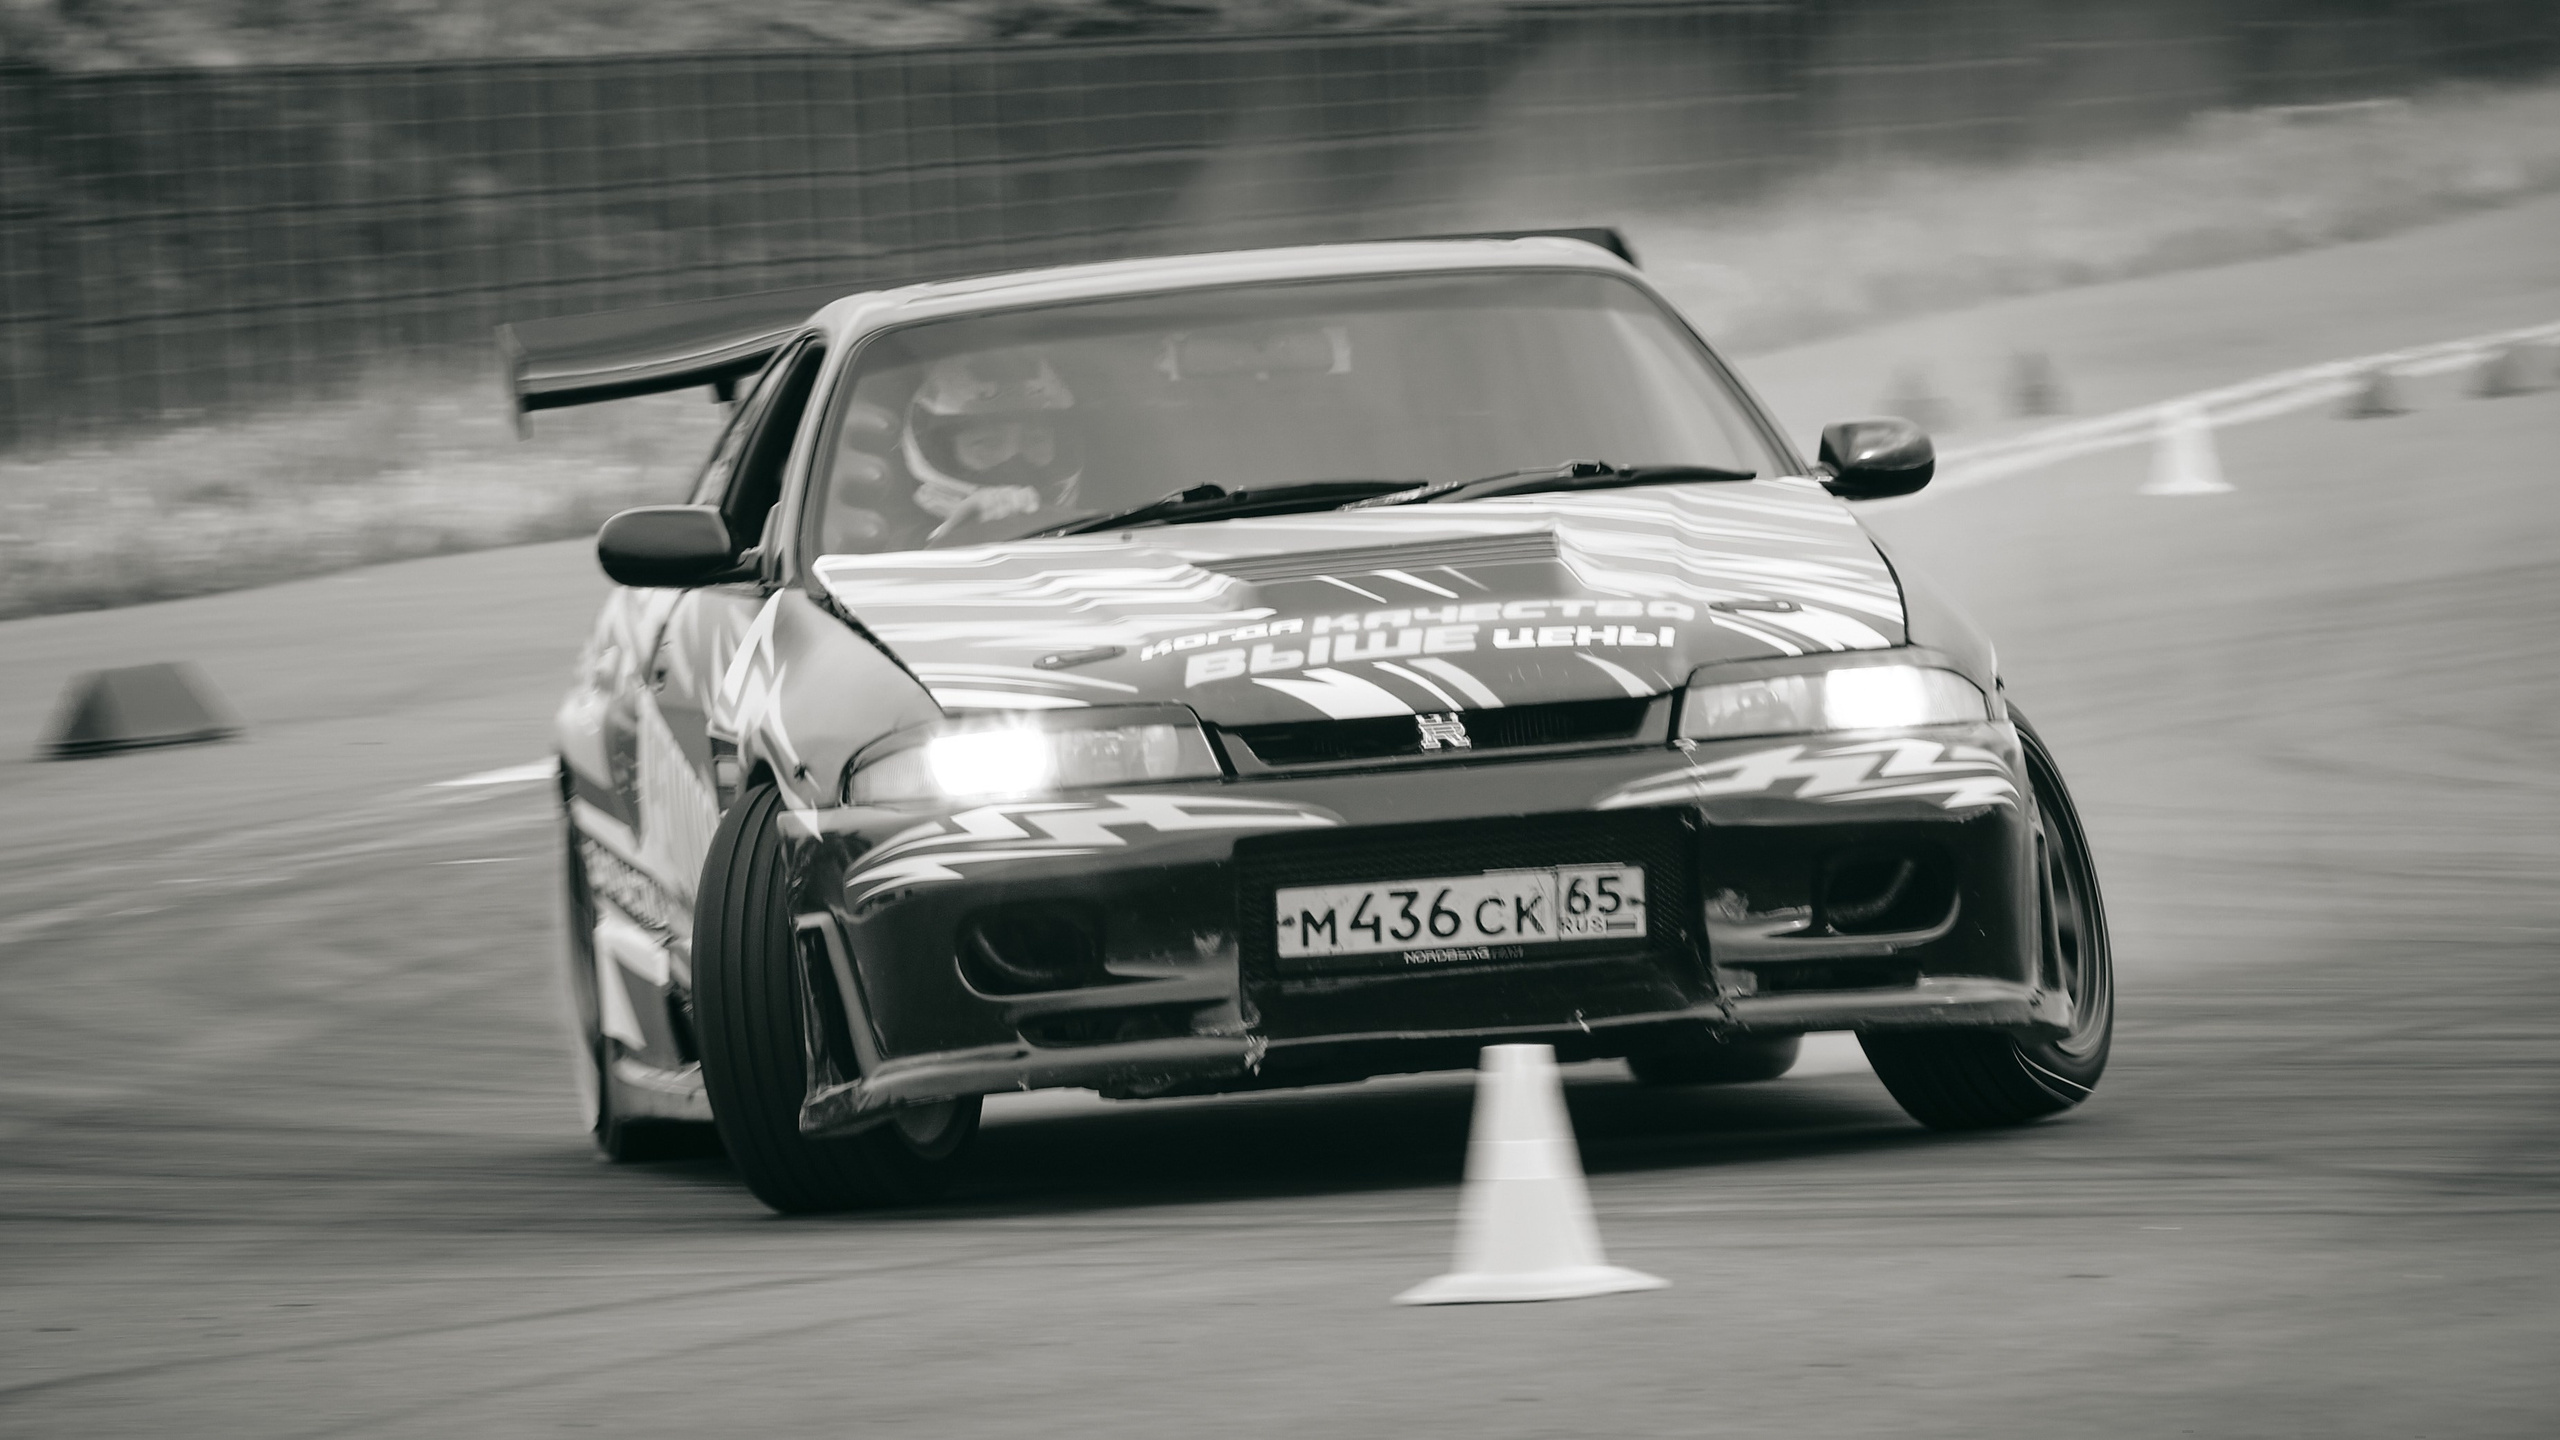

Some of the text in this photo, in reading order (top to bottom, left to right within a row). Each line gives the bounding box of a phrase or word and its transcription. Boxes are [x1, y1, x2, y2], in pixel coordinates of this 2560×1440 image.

[1141, 618, 1304, 662] КОГДА
[1185, 624, 1676, 689] ВЫШЕ ЦЕНЫ
[1567, 876, 1622, 915] 65
[1559, 916, 1604, 934] RUS
